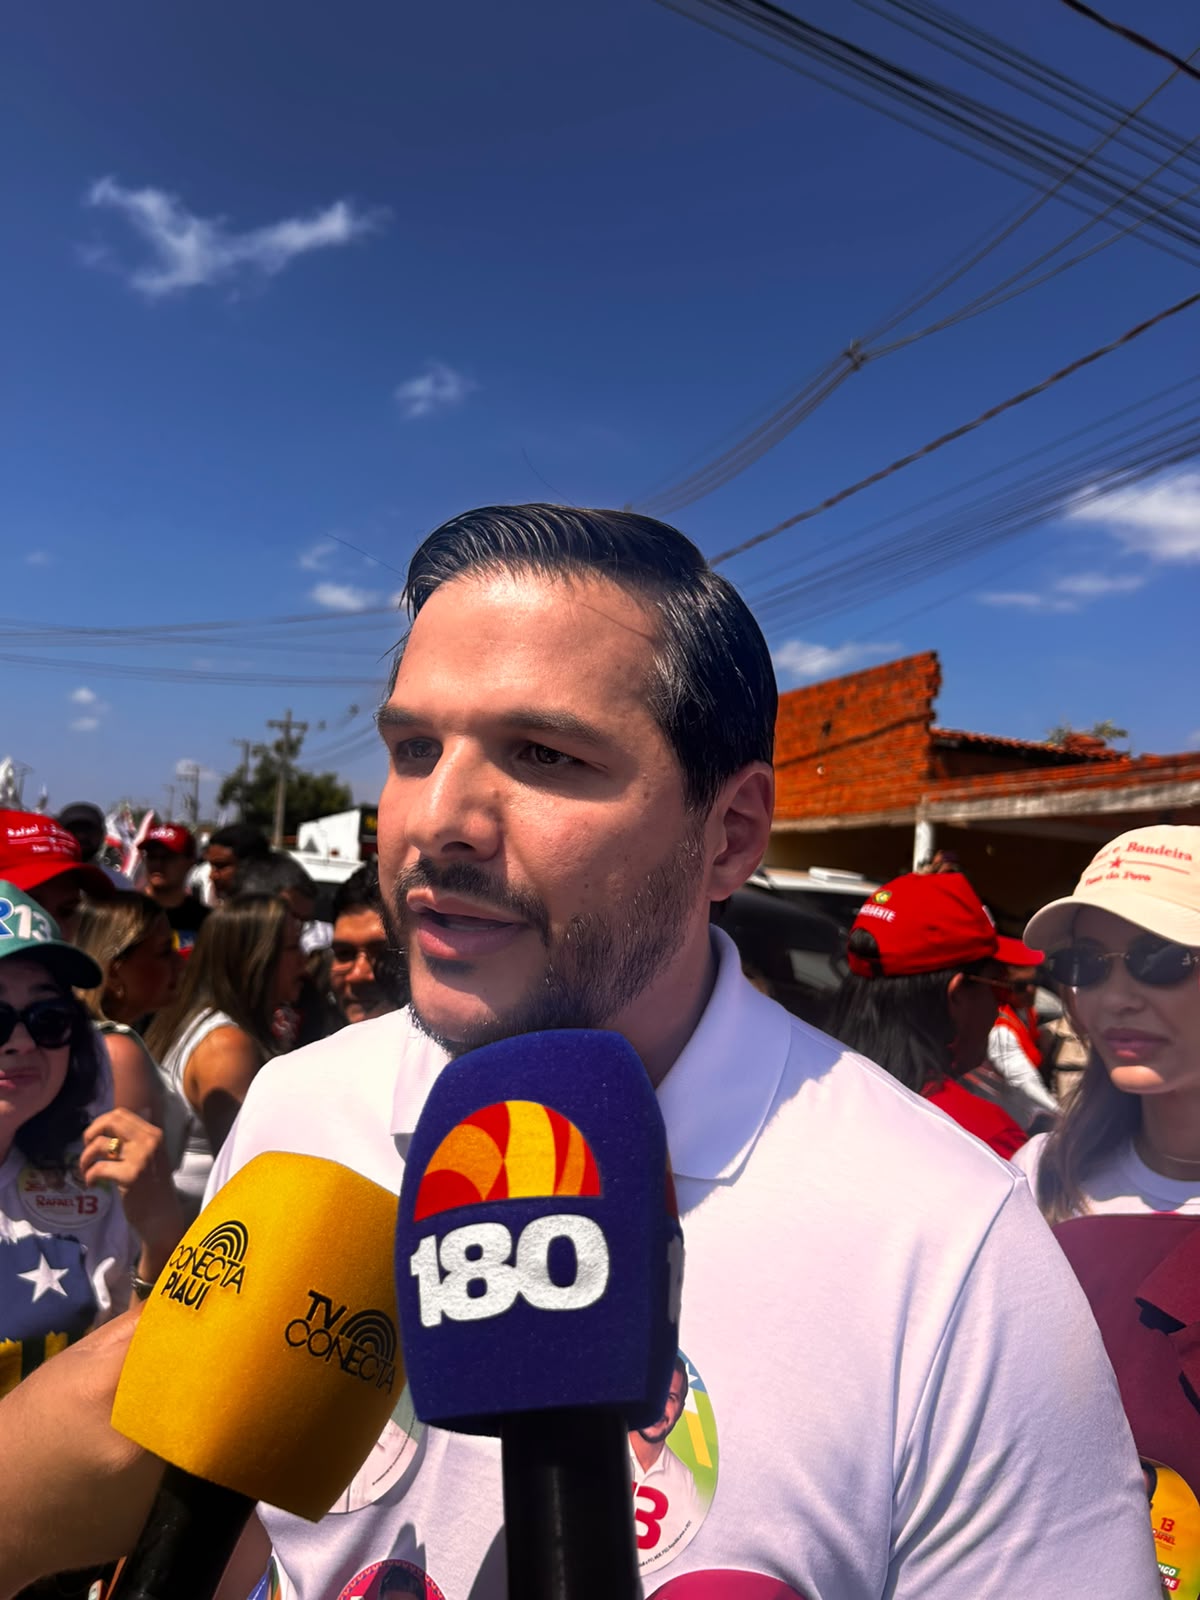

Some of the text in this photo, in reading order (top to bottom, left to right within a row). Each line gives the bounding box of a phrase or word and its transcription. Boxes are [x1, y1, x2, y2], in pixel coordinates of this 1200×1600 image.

[1126, 841, 1192, 861] Bandeira
[76, 1195, 98, 1215] 13
[169, 1245, 246, 1295] CONECTA
[410, 1213, 610, 1328] 180
[306, 1289, 347, 1330] TV
[285, 1319, 396, 1394] CONECTA
[632, 1481, 669, 1550] 3
[1161, 1517, 1175, 1532] 13
